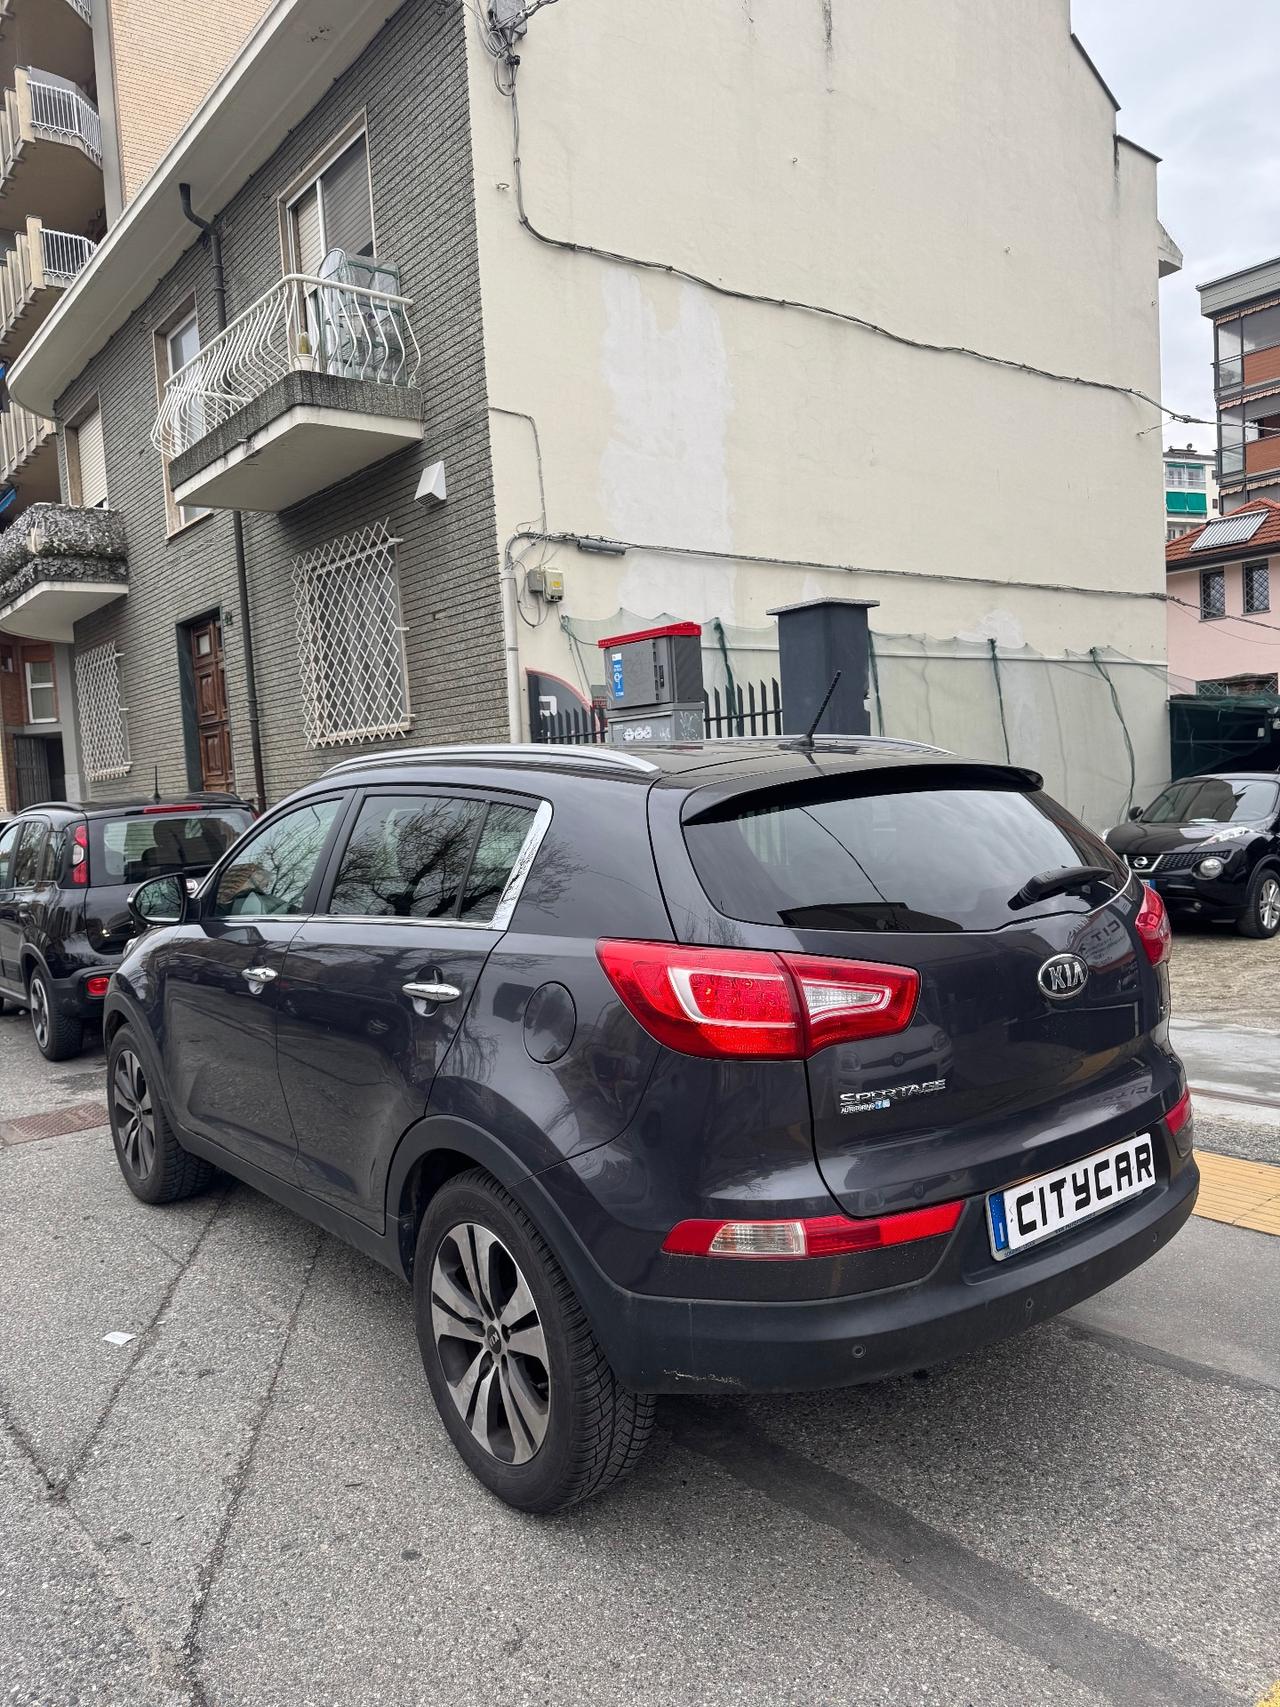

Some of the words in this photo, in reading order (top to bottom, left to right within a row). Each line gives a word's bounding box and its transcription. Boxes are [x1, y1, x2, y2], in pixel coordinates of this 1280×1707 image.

[1049, 961, 1085, 991] KIA
[840, 1079, 946, 1106] SPORTAGE
[1015, 1142, 1153, 1236] CITYCAR
